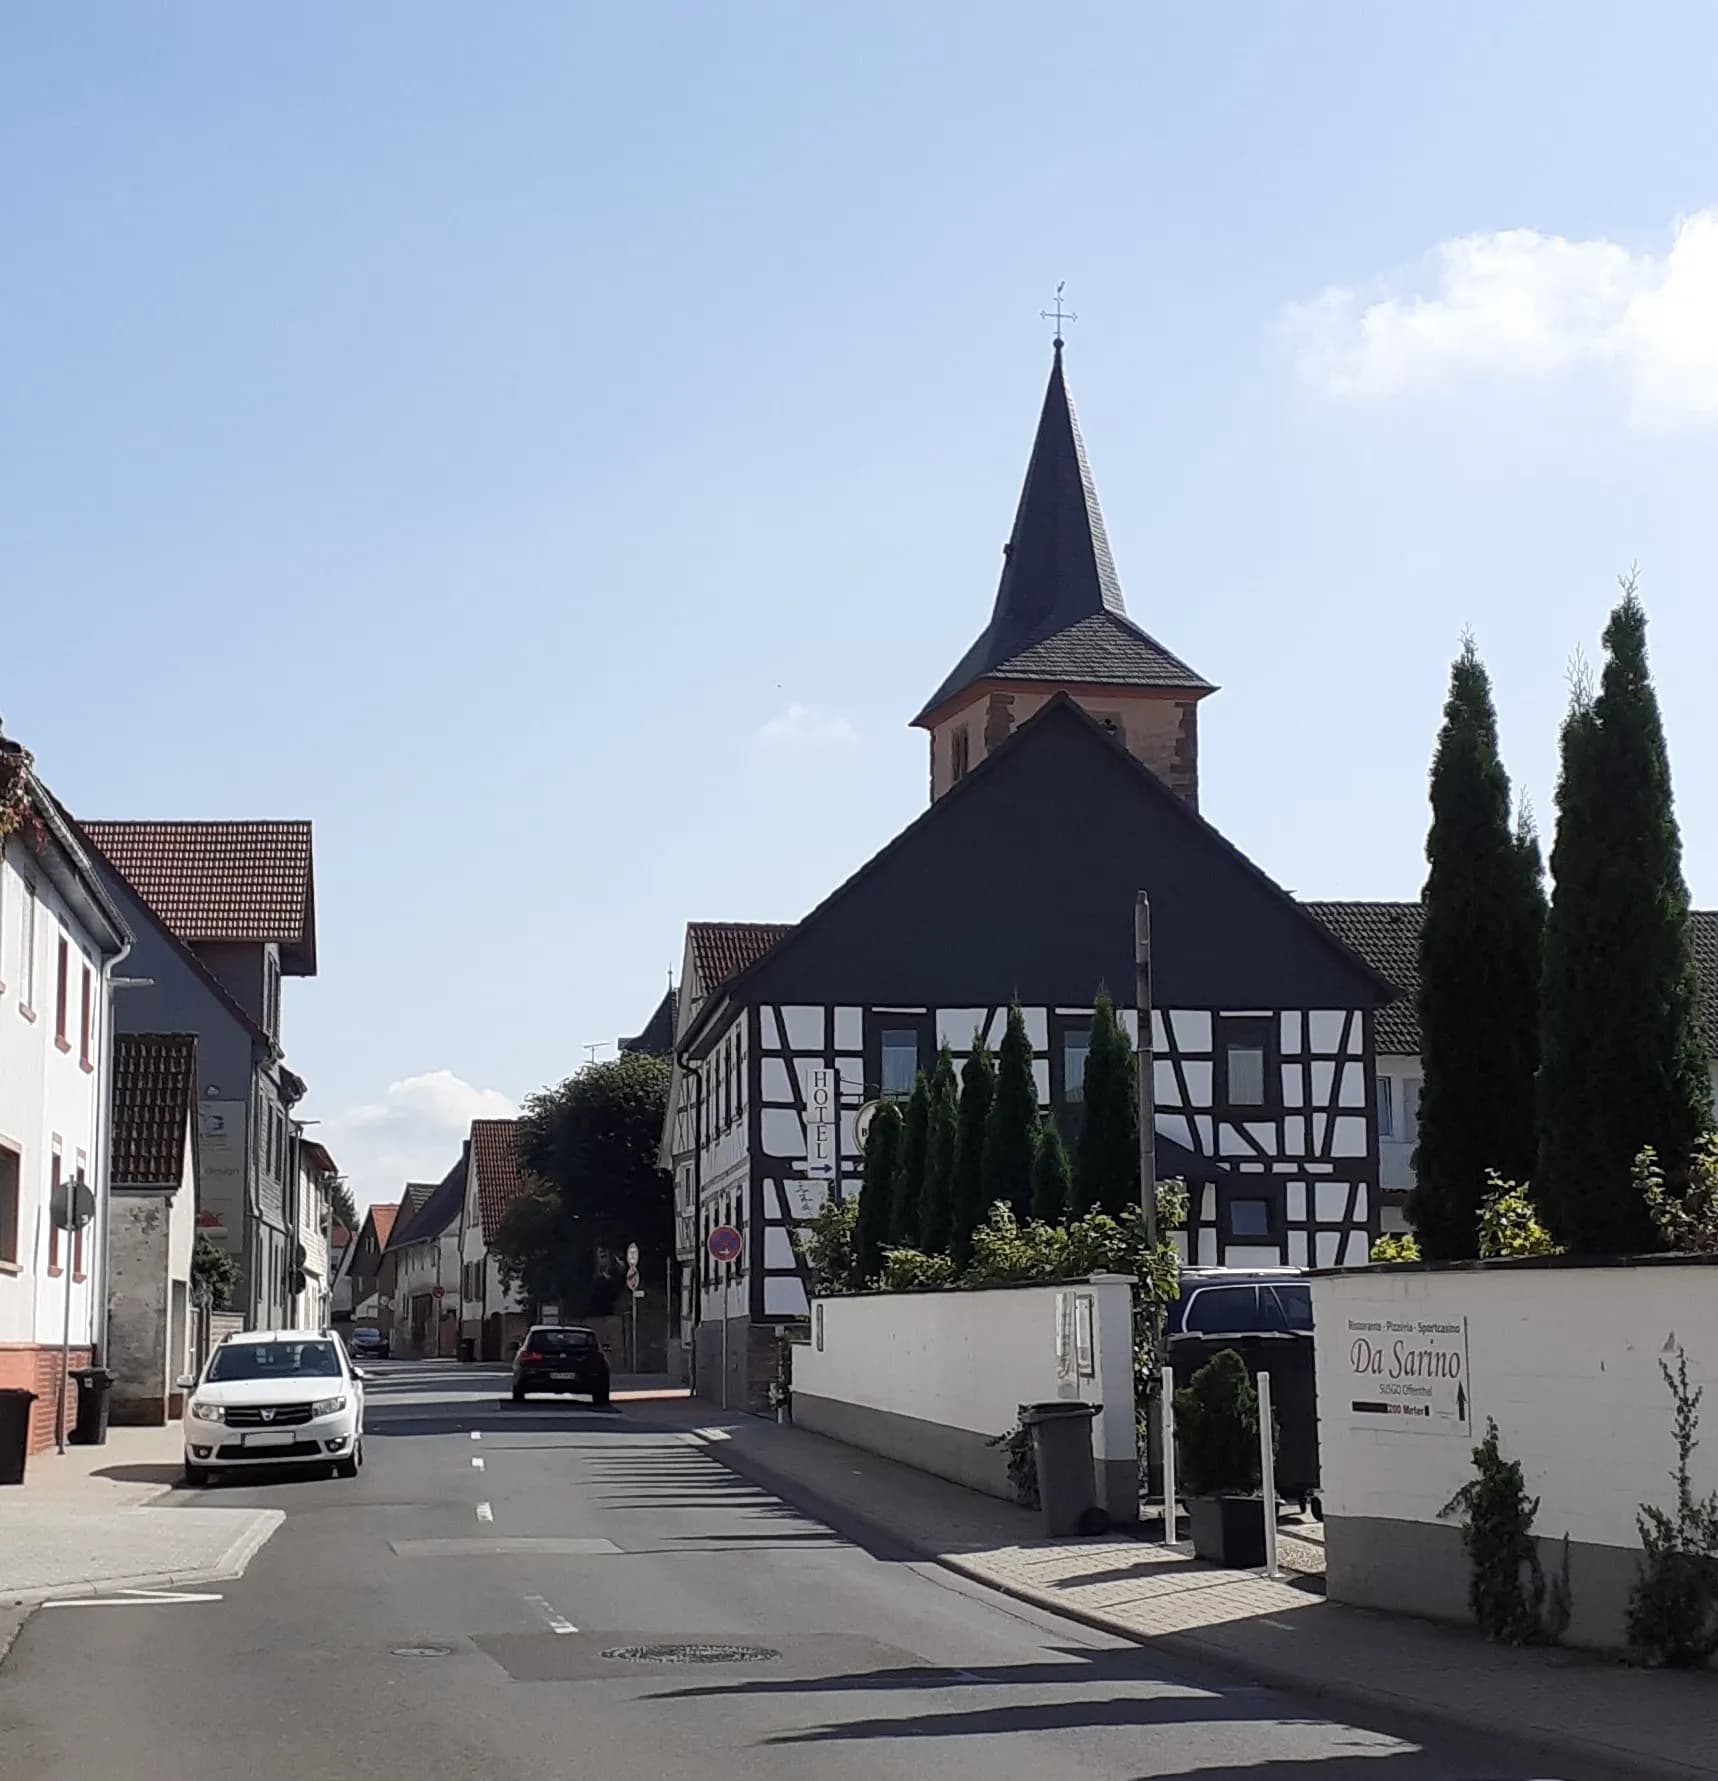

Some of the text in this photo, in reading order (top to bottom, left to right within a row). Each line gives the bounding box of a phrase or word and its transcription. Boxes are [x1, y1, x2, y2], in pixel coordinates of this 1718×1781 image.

[813, 1070, 829, 1160] HOTEL
[1386, 1321, 1413, 1332] Pizzeria
[1350, 1338, 1461, 1379] Da Sarino
